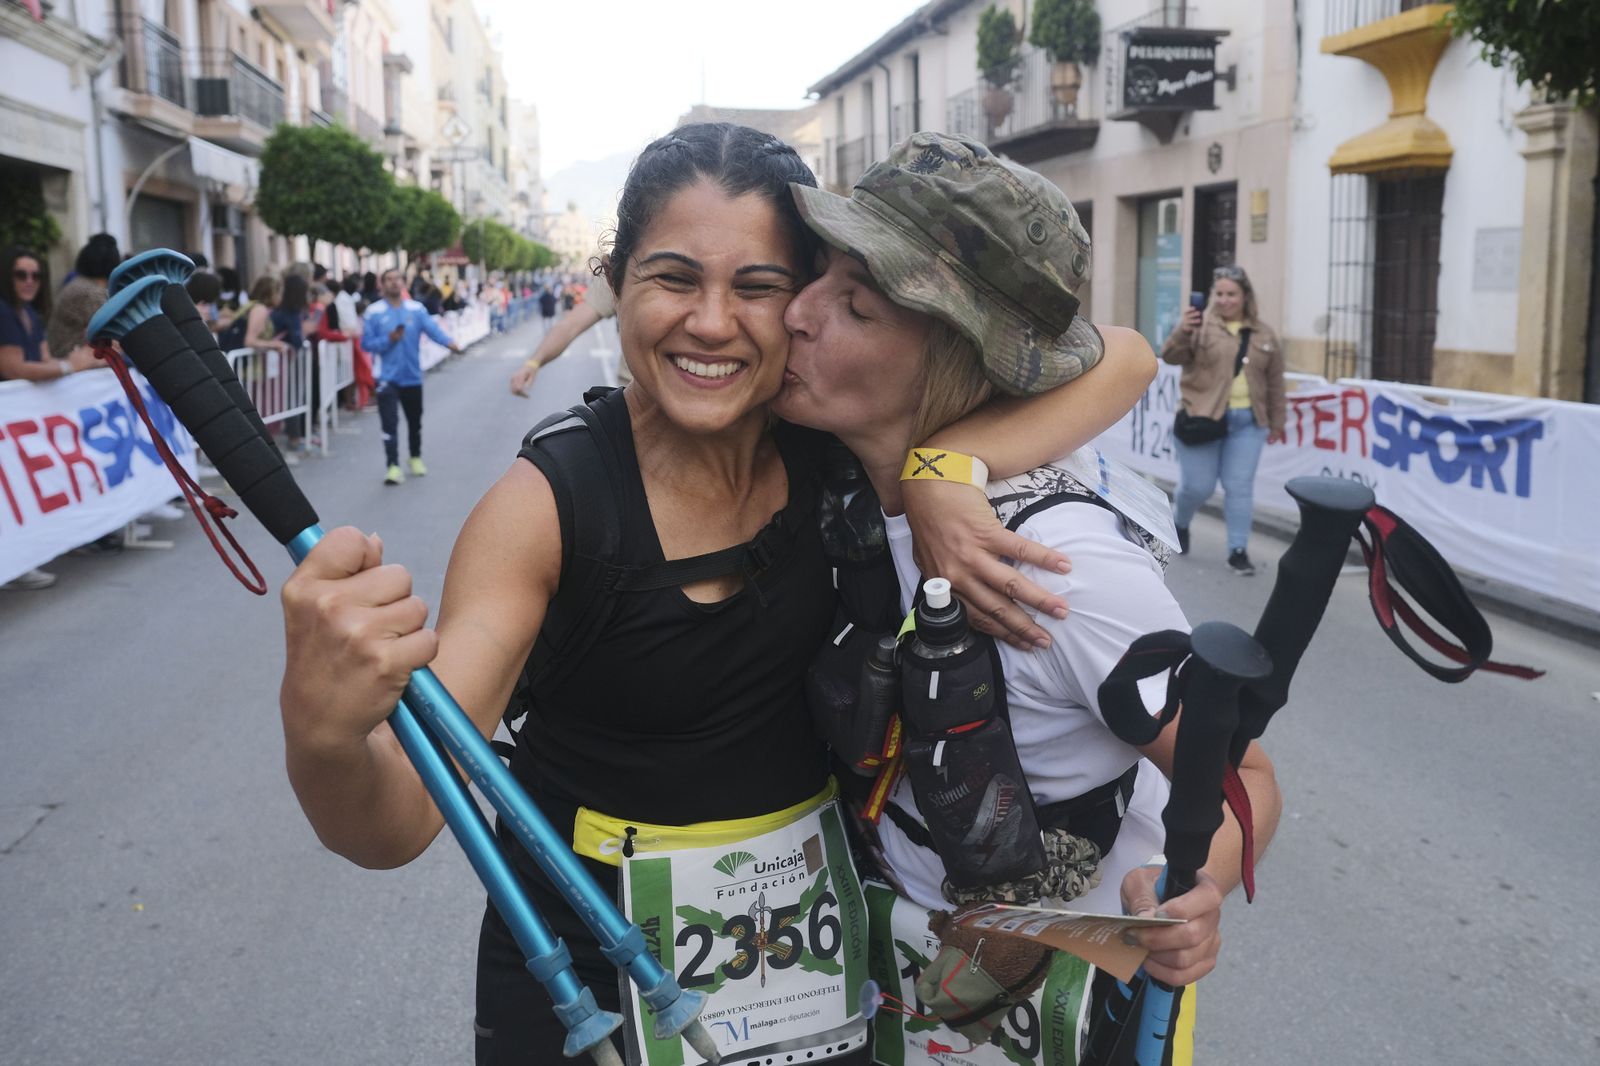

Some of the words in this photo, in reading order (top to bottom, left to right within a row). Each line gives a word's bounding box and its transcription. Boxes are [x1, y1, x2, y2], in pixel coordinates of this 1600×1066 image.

[754, 848, 804, 874] Unicaja
[717, 871, 805, 900] Fundación
[675, 891, 843, 989] 2356
[727, 997, 782, 1015] EMERGENCIA
[784, 994, 796, 1004] DE
